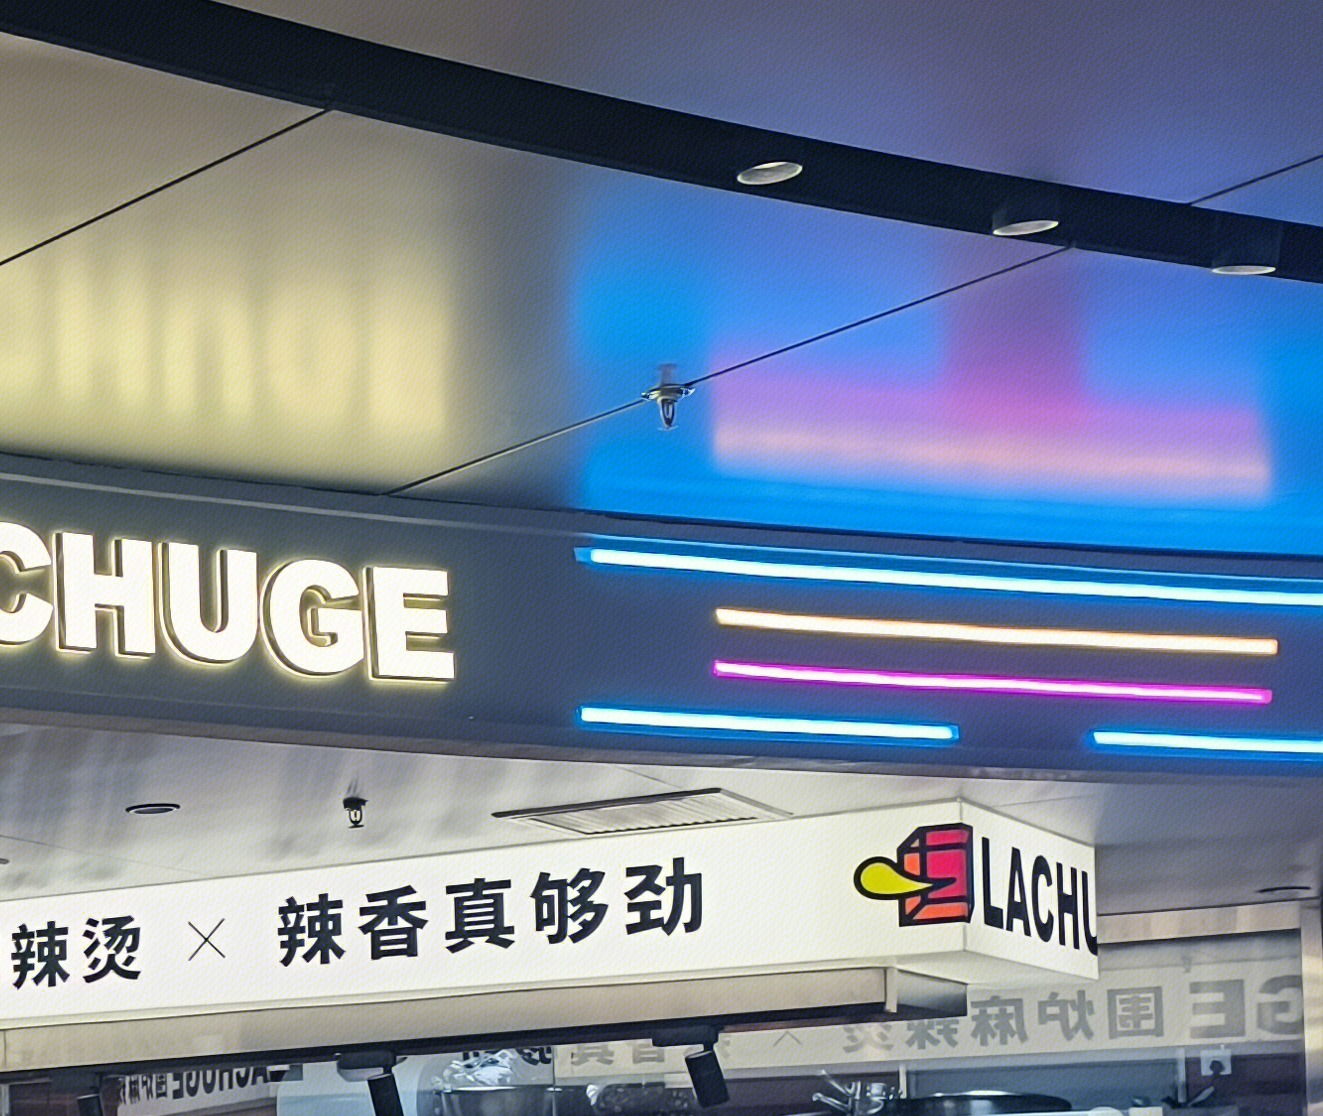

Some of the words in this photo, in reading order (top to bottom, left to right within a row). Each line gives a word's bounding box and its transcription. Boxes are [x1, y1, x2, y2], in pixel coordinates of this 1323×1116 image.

[277, 856, 704, 967] 辣香真够劲
